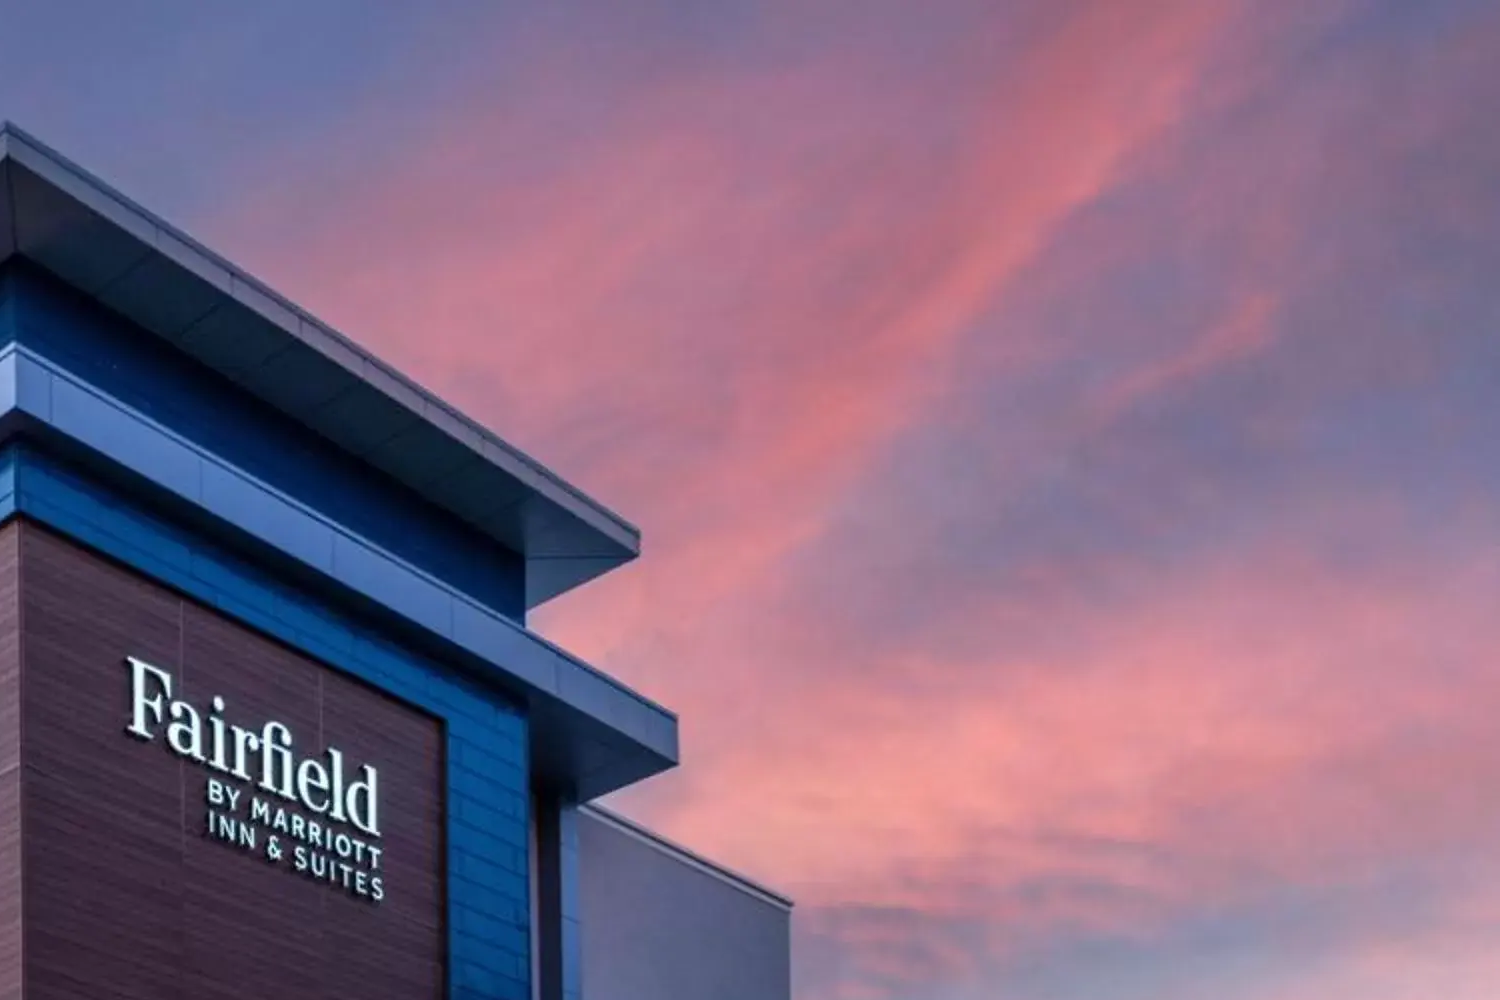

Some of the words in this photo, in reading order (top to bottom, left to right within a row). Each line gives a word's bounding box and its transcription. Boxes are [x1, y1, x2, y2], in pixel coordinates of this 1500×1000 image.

[126, 655, 380, 836] Fairfield
[208, 779, 241, 811] BY
[252, 796, 382, 869] MARRIOTT
[208, 809, 255, 849] INN
[268, 835, 282, 860] &
[294, 846, 384, 901] SUITES
